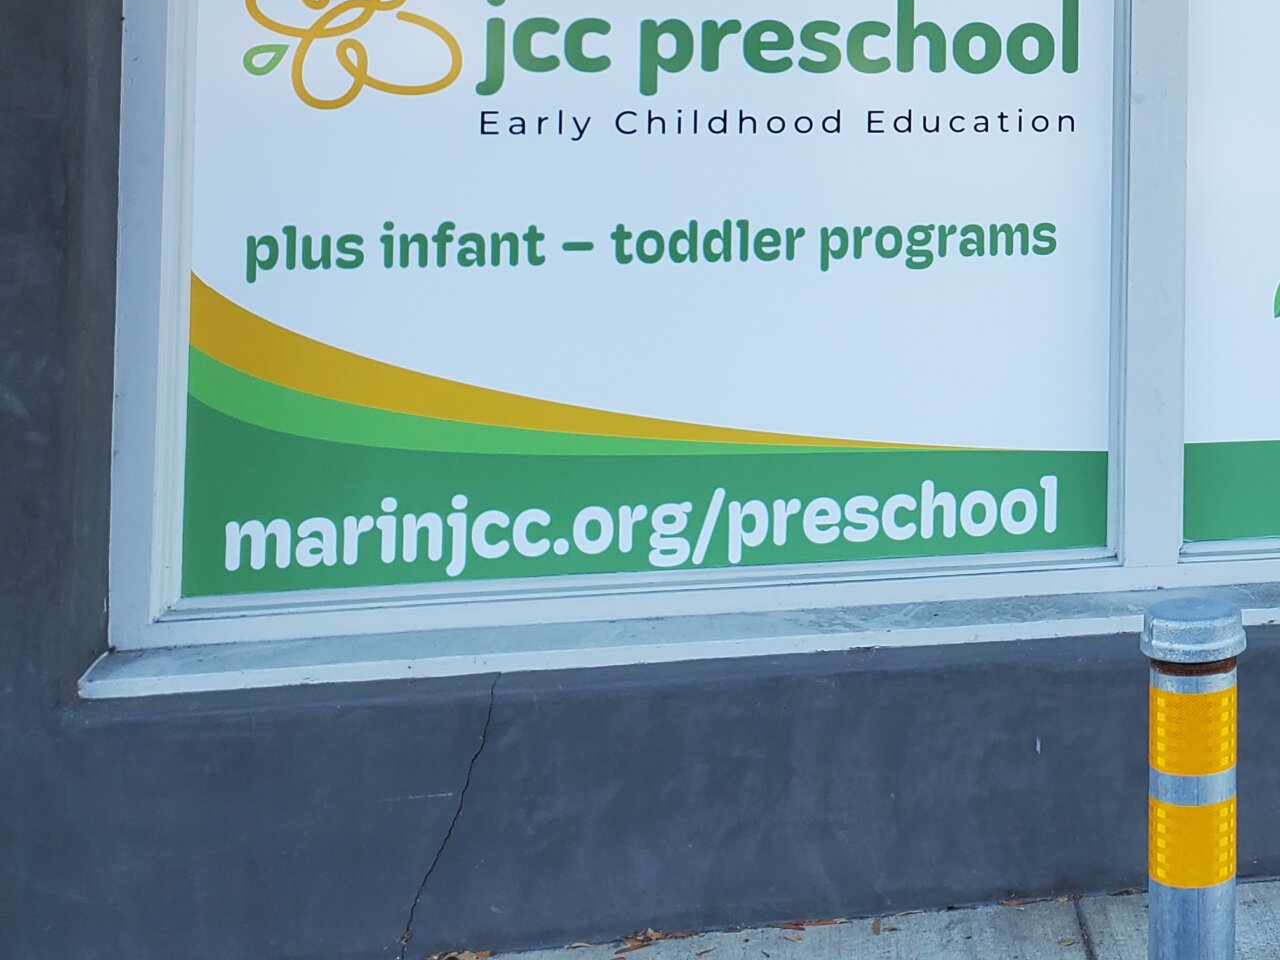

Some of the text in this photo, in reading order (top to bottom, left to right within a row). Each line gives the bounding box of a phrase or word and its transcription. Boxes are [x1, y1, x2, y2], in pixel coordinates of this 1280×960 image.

[480, 108, 1077, 141] Early Childhood Education
[246, 225, 364, 284] plus
[380, 221, 545, 269] infant
[610, 219, 805, 264] toddler
[820, 223, 1056, 272] programs
[224, 476, 1059, 577] marinjcc.org/preschool
